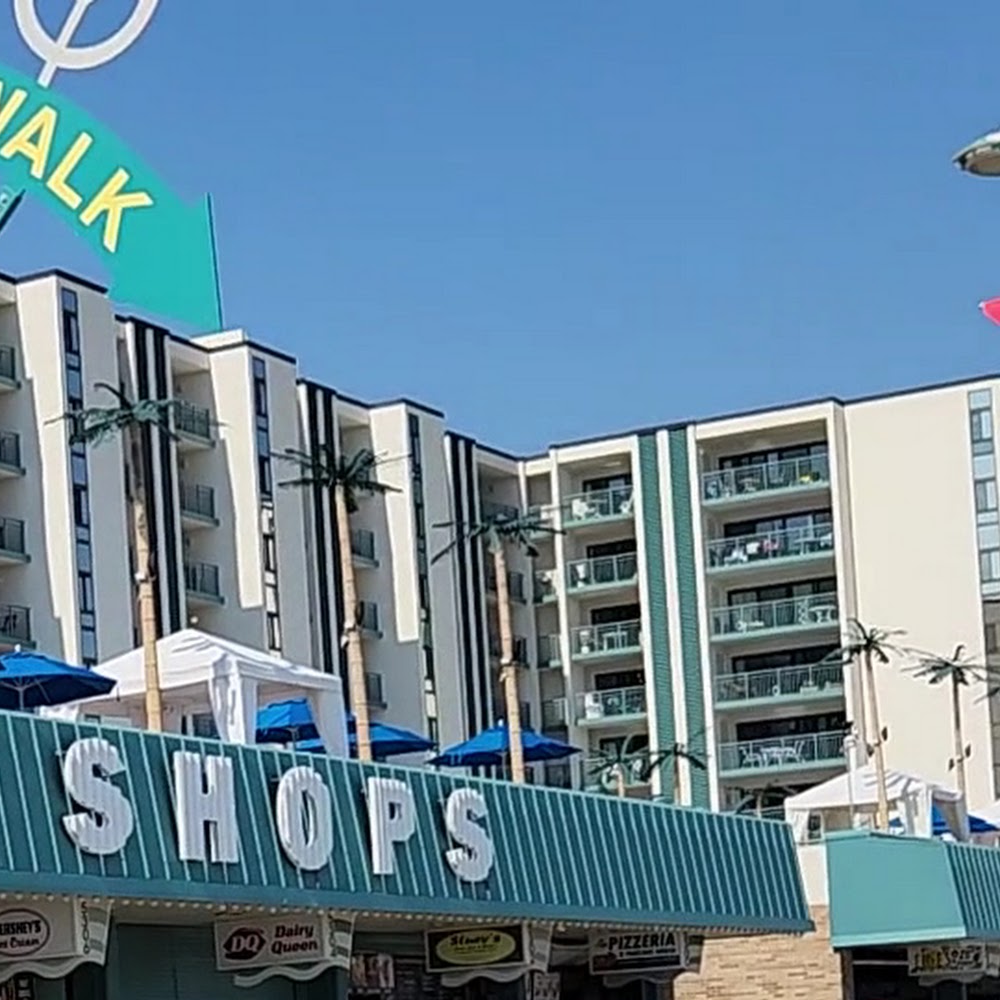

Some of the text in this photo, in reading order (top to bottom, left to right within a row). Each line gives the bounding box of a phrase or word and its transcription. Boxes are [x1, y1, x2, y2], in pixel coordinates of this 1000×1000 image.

[62, 737, 496, 884] SHOPS
[274, 923, 315, 939] Dairy
[607, 931, 676, 950] PIZZERIA
[231, 935, 260, 954] DQ
[270, 939, 319, 955] Queen
